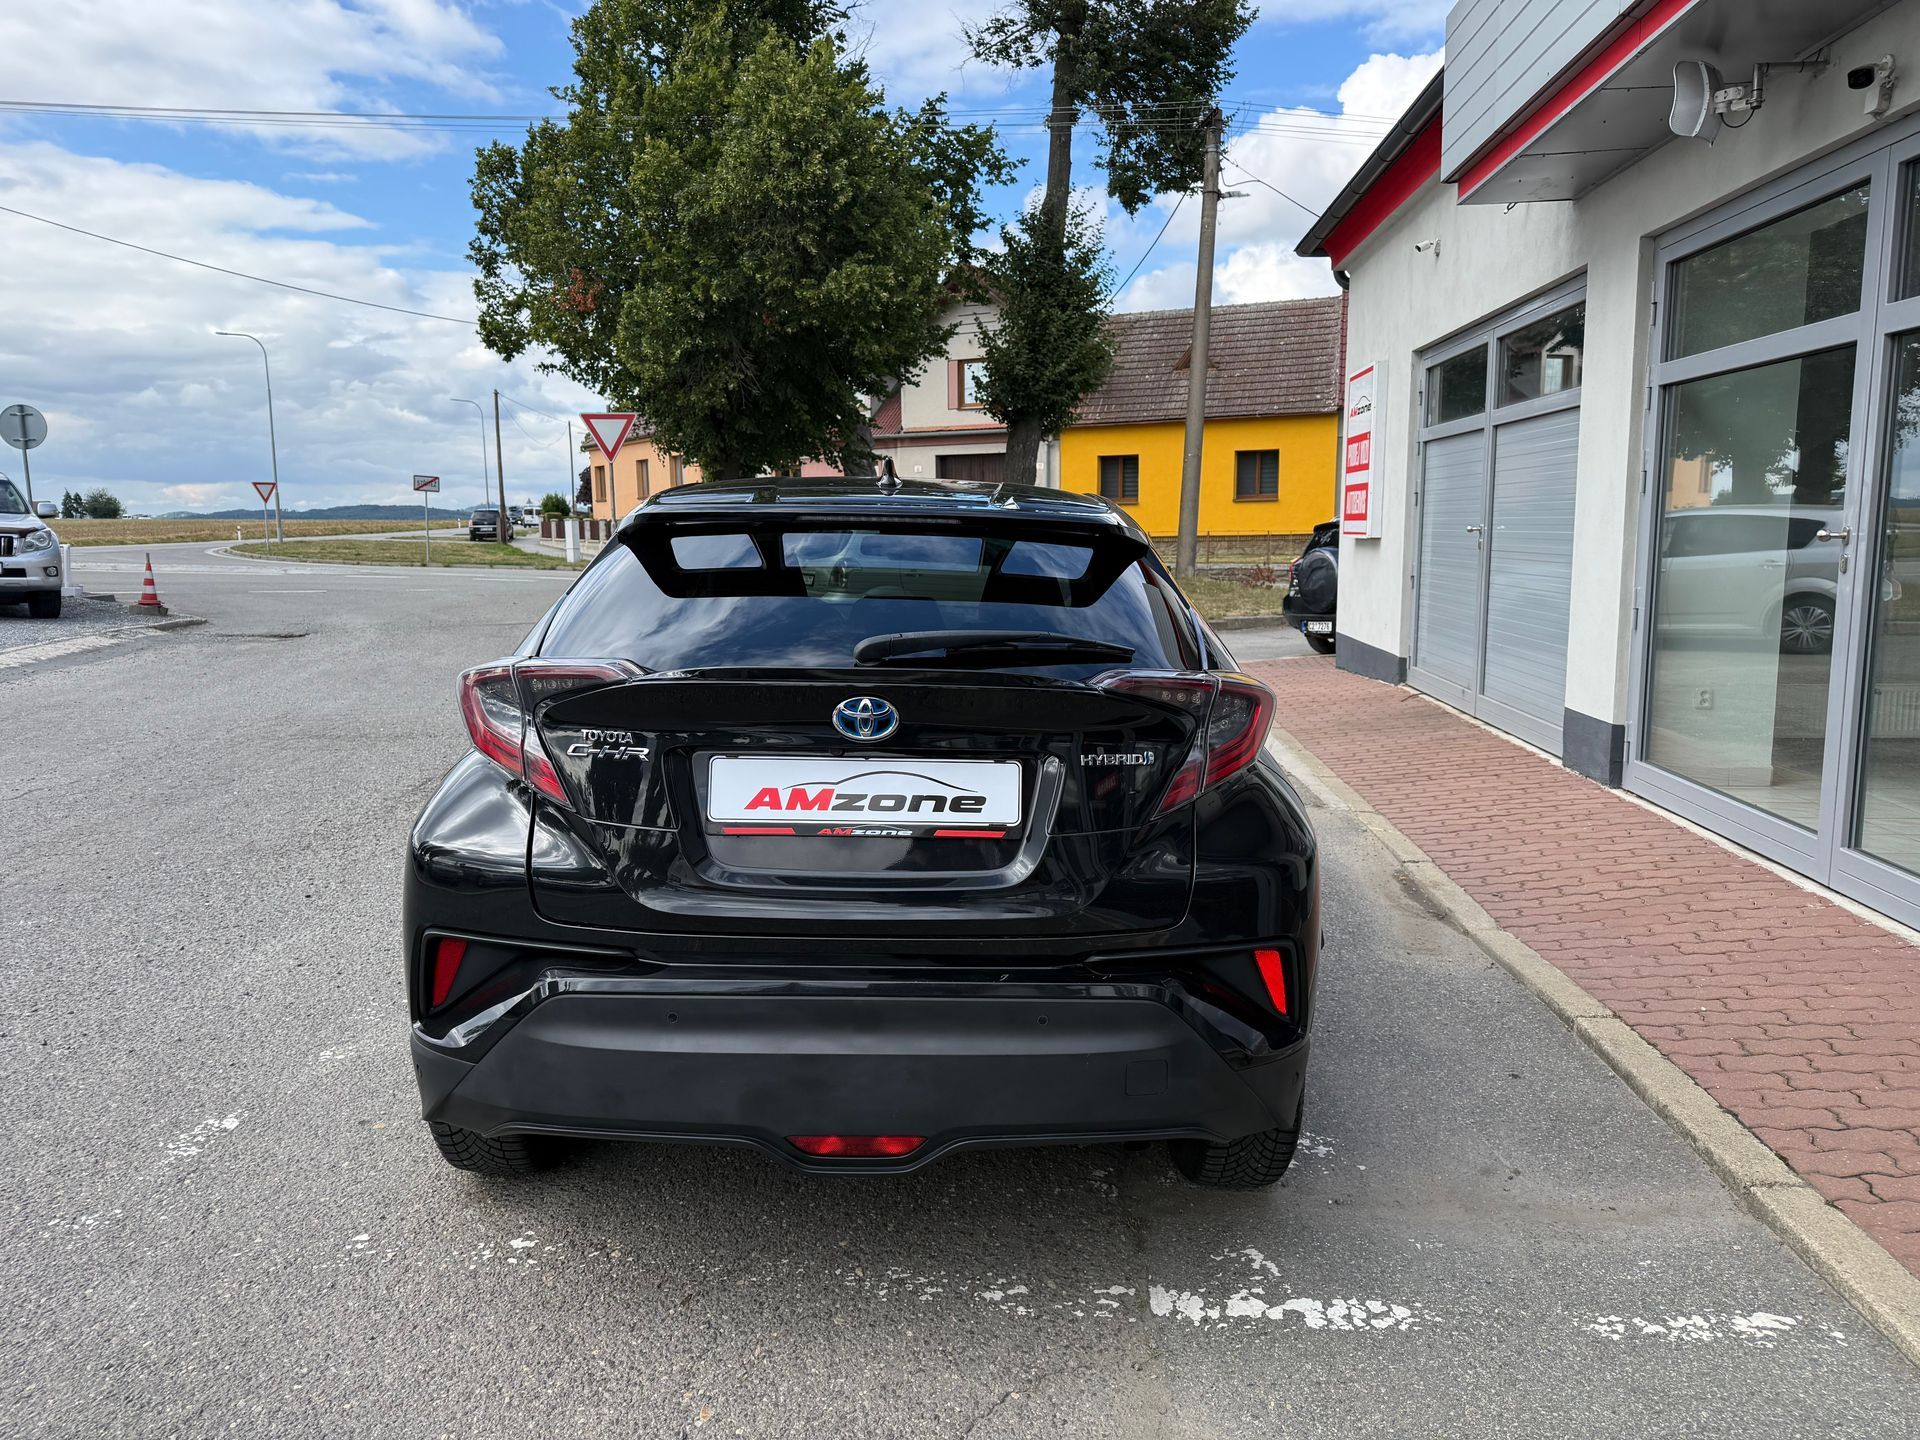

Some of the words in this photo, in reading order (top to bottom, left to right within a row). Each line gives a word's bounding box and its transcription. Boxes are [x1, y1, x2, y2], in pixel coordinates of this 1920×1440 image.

[581, 729, 633, 744] TOYOTA
[1081, 754, 1143, 766] HYBRID
[744, 787, 987, 813] AMzone
[817, 827, 912, 836] AMzone
